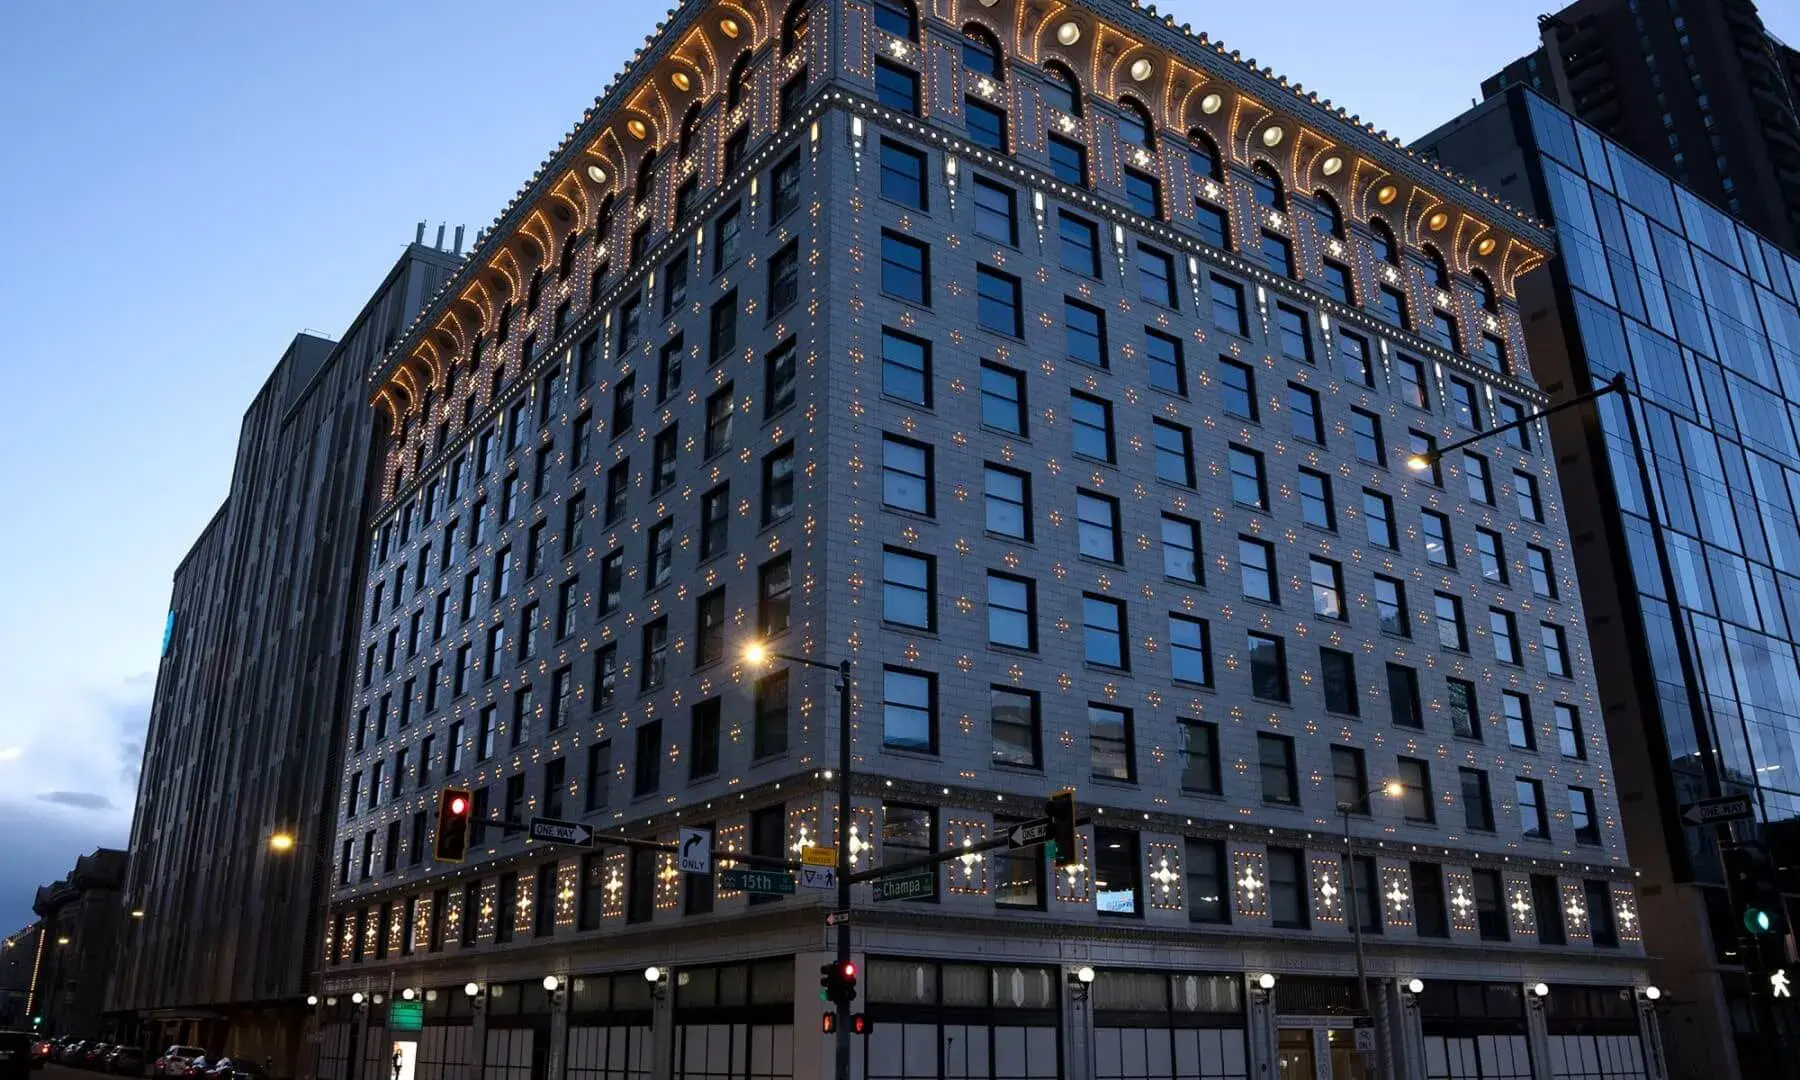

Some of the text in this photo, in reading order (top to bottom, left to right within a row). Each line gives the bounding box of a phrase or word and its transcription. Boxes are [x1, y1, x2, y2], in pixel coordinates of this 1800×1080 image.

[536, 825, 575, 838] ONE WAY
[1023, 828, 1036, 839] ONE
[682, 859, 704, 870] ONLY
[741, 874, 772, 890] 15th
[883, 879, 921, 896] Champa
